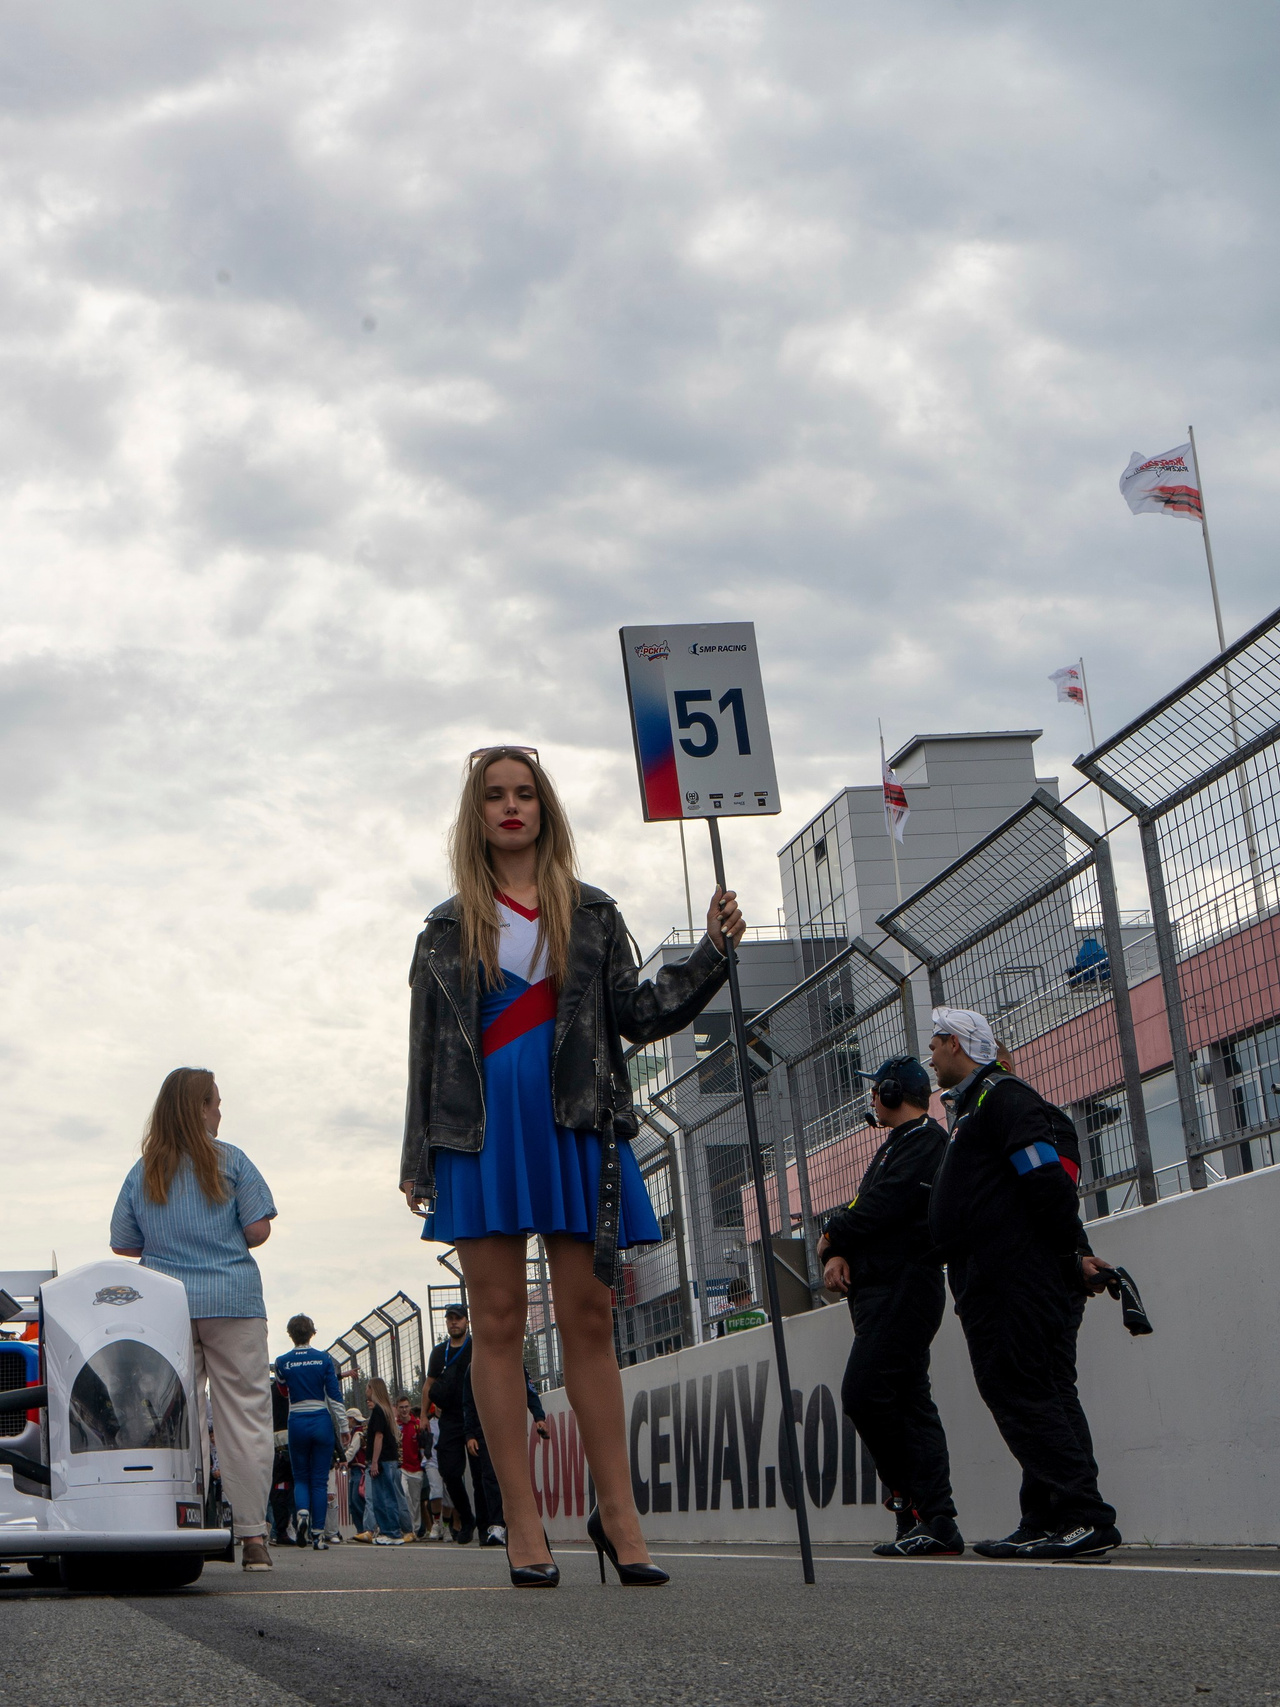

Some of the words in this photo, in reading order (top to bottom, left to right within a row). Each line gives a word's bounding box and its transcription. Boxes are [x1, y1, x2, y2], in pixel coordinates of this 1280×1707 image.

[717, 644, 747, 653] RACING
[674, 688, 752, 758] 51
[728, 1317, 762, 1328] ПРЕССА
